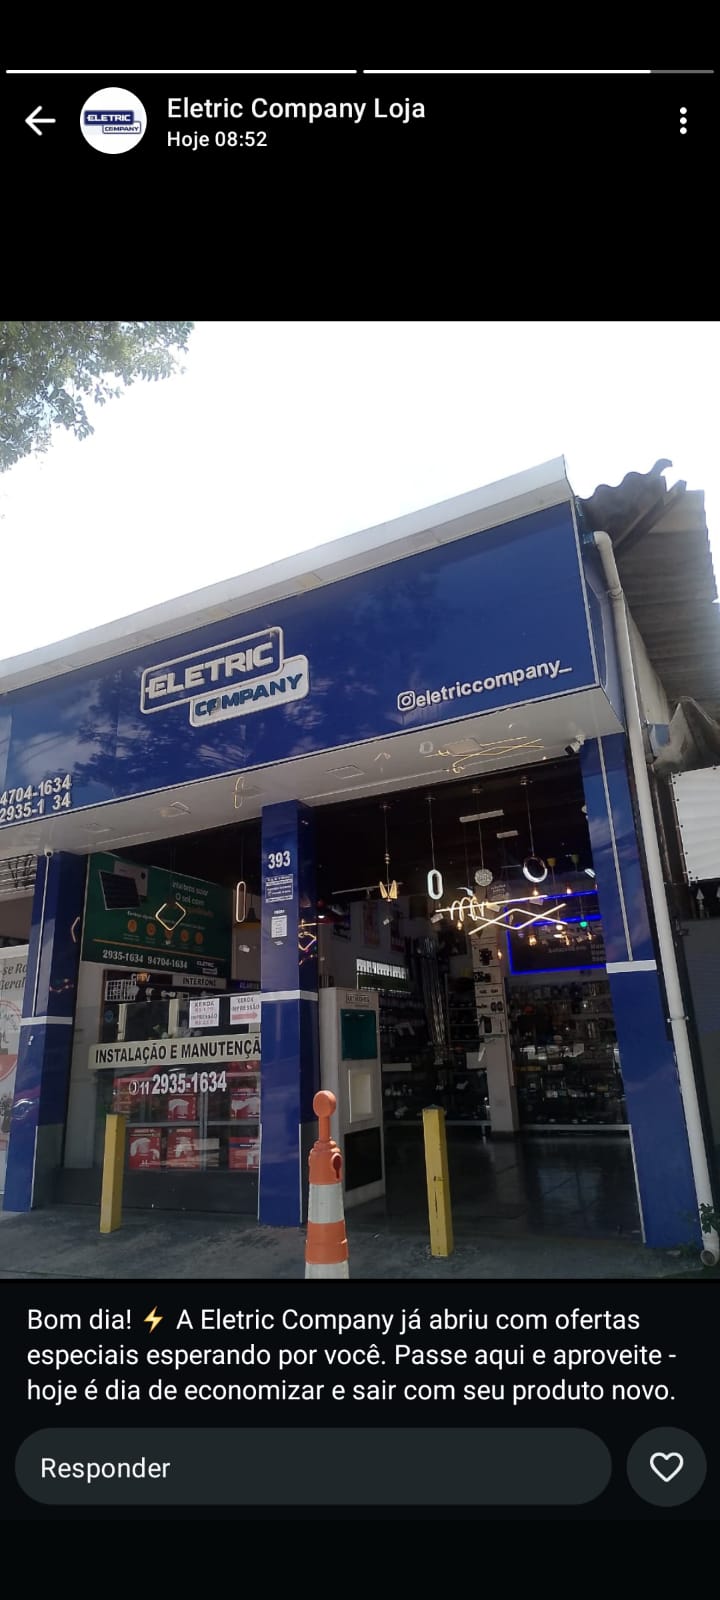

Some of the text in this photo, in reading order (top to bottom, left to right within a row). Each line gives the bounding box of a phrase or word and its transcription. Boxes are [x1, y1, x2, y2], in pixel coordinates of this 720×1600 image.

[145, 642, 273, 699] ELETRIC
[268, 850, 291, 869] 393
[102, 949, 188, 969] 2935-1634 94704-1634
[95, 1036, 261, 1064] INSTALAÇÃO E MANUTENÇÃ
[139, 1081, 150, 1095] 11
[152, 1070, 228, 1095] 2935-1634
